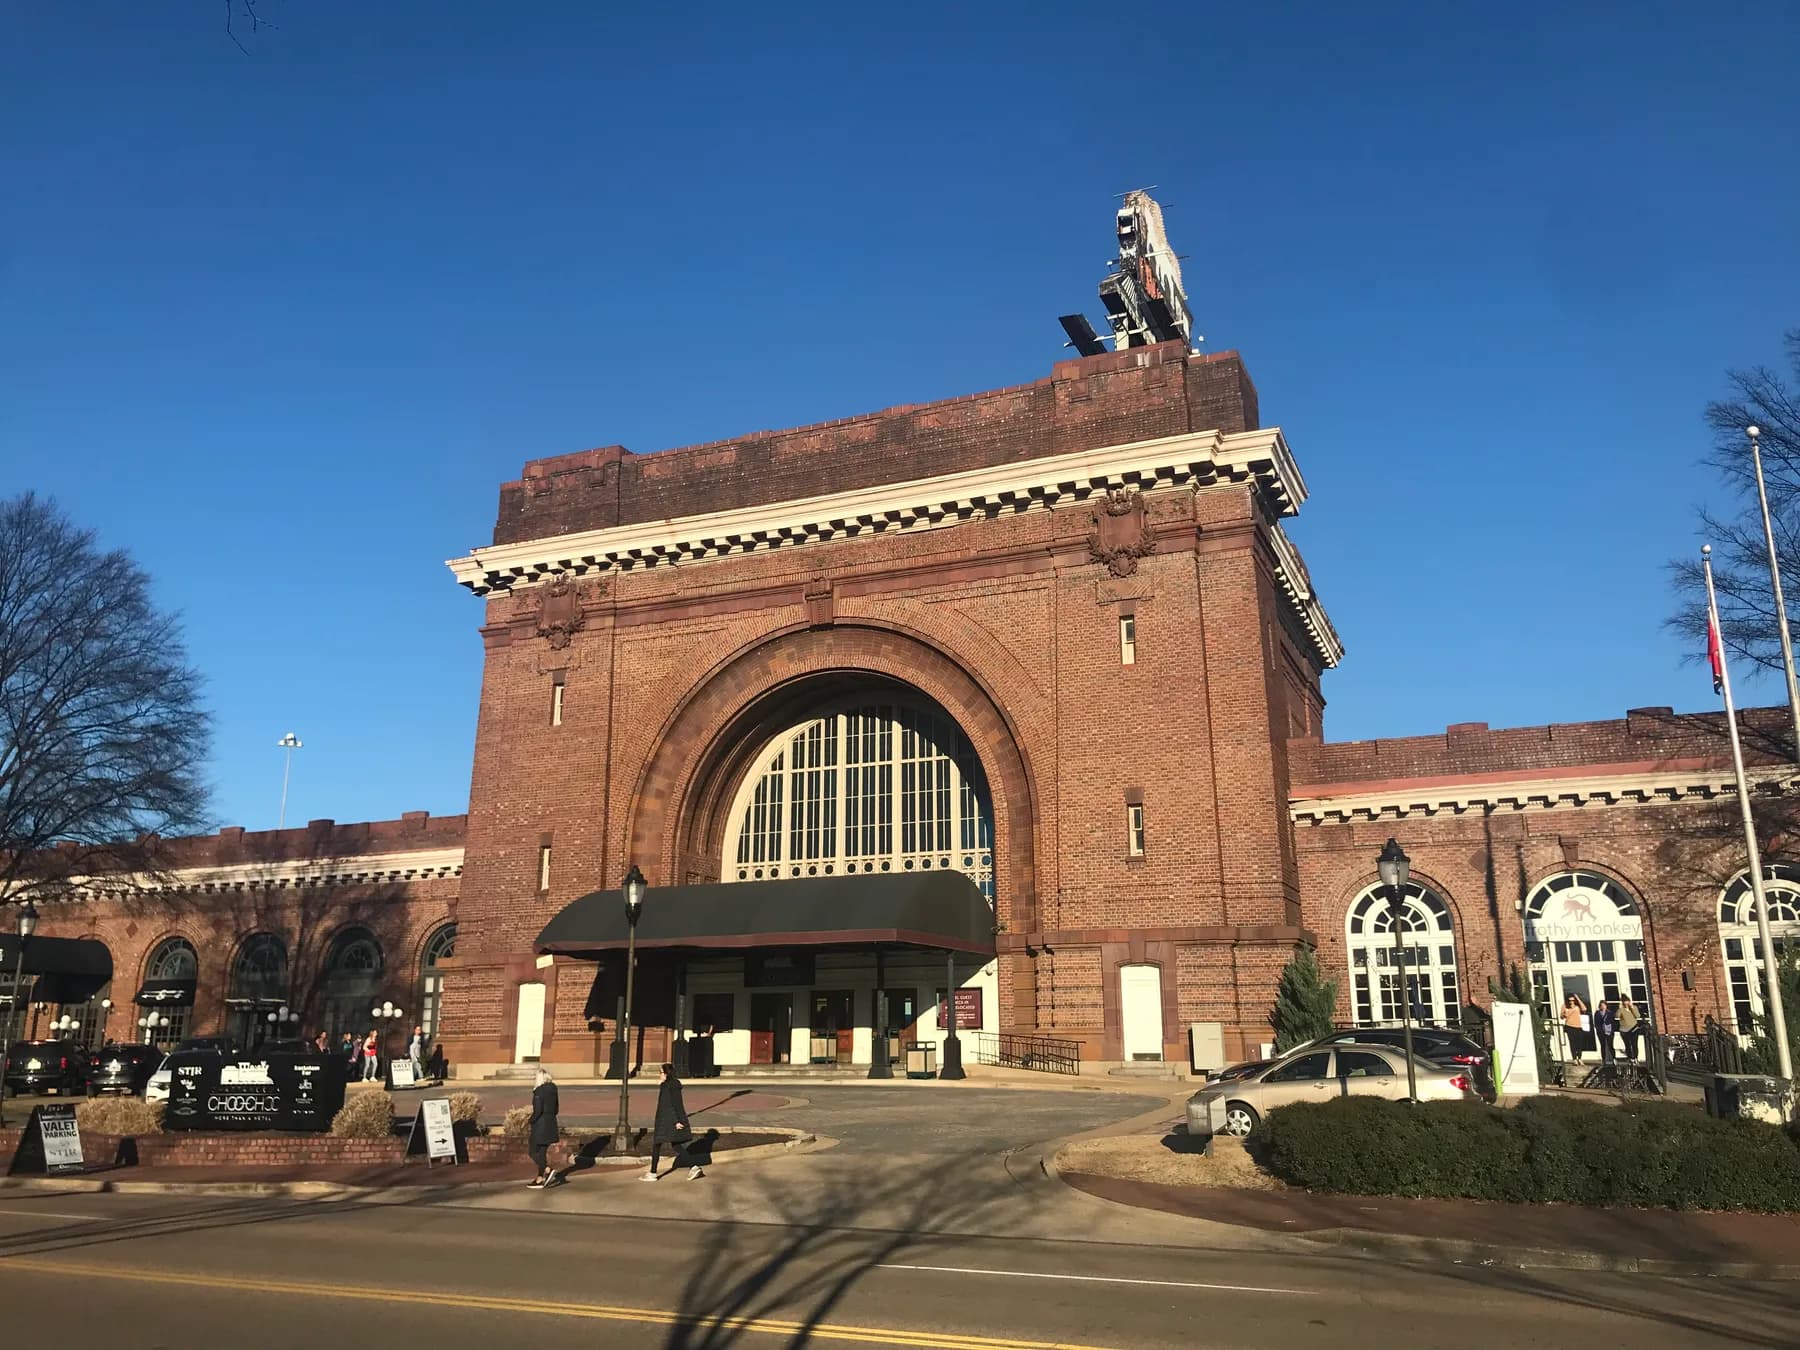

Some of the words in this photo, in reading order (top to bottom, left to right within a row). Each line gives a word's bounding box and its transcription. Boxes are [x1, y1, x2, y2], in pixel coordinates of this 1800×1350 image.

[1525, 921, 1571, 938] frothy
[1576, 921, 1641, 937] monkey
[178, 1066, 202, 1076] STIR
[43, 1121, 75, 1132] VALET
[44, 1130, 77, 1139] PARKING
